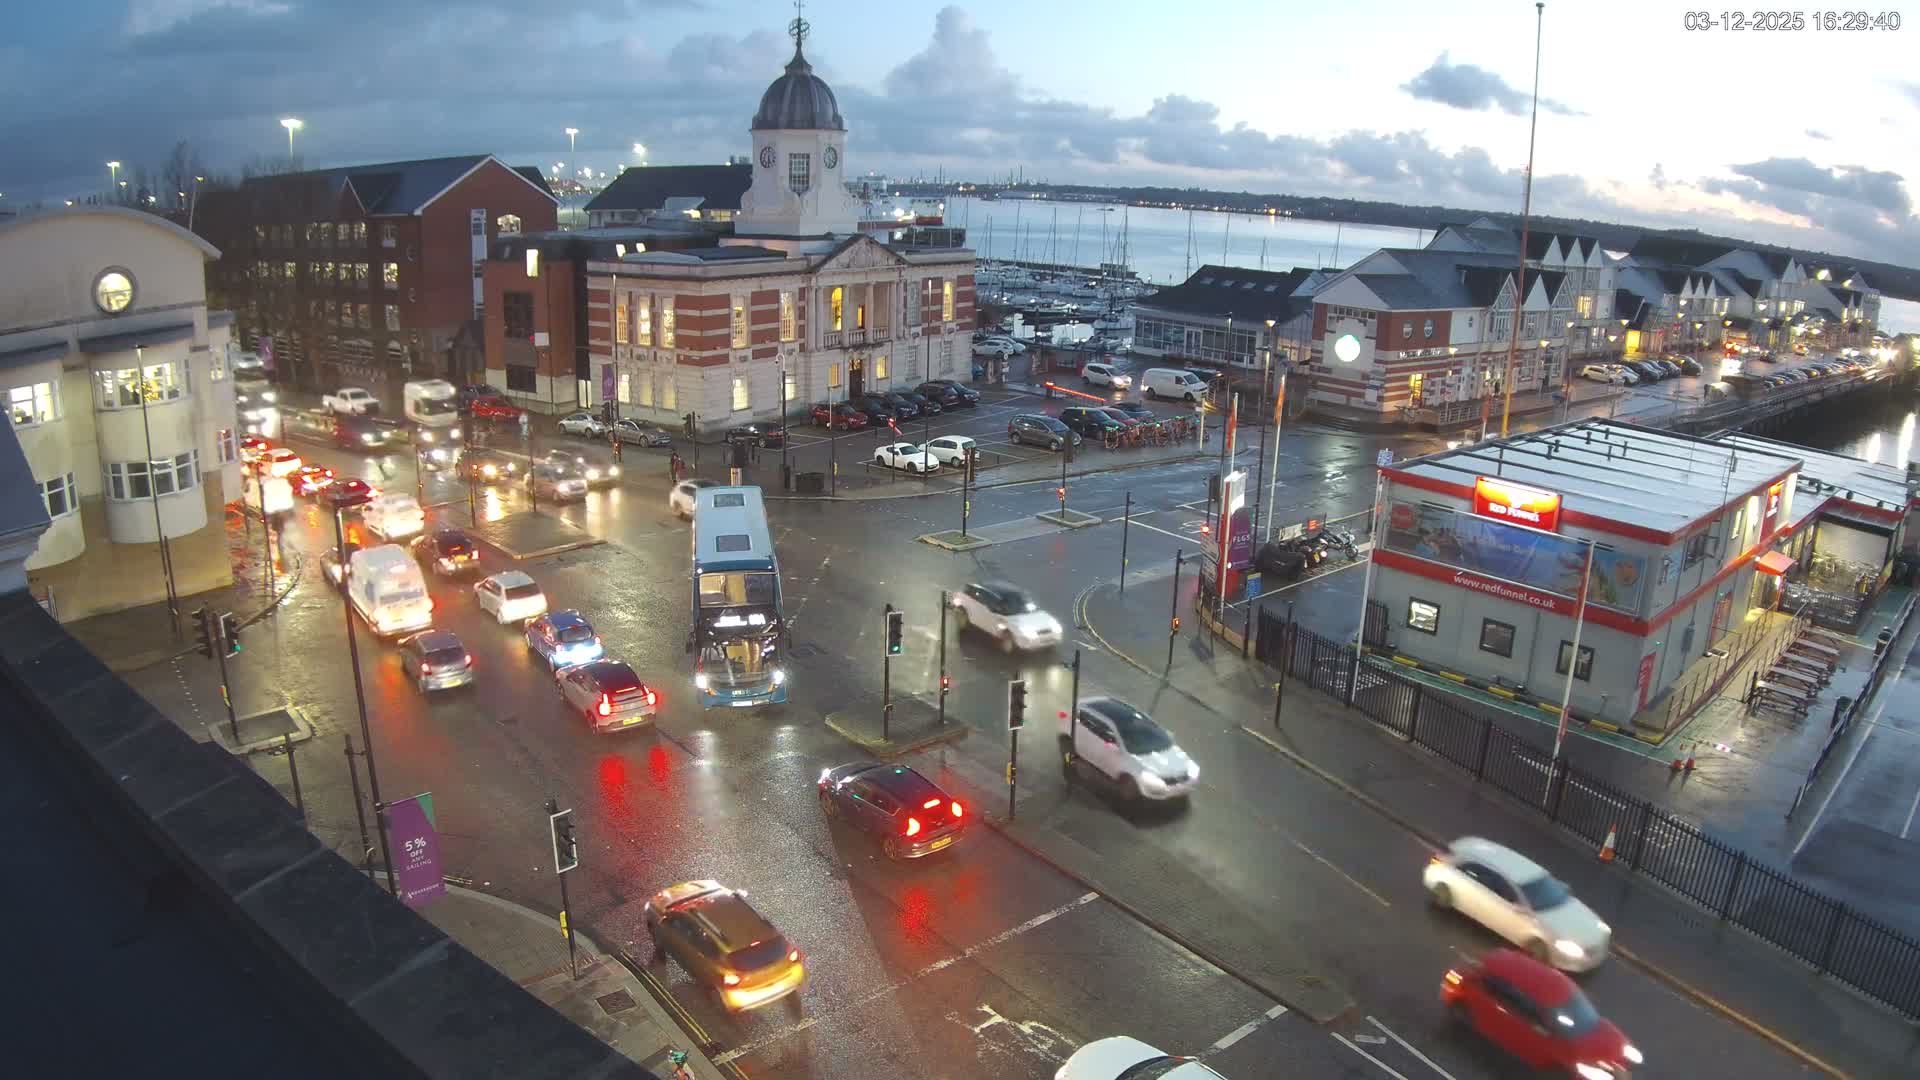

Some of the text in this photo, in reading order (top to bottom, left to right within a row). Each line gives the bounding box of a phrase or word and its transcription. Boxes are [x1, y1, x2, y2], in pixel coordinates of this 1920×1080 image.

[1454, 576, 1556, 608] www.redfunnel.co.uk
[405, 837, 427, 852] 5%
[410, 849, 423, 857] OFF
